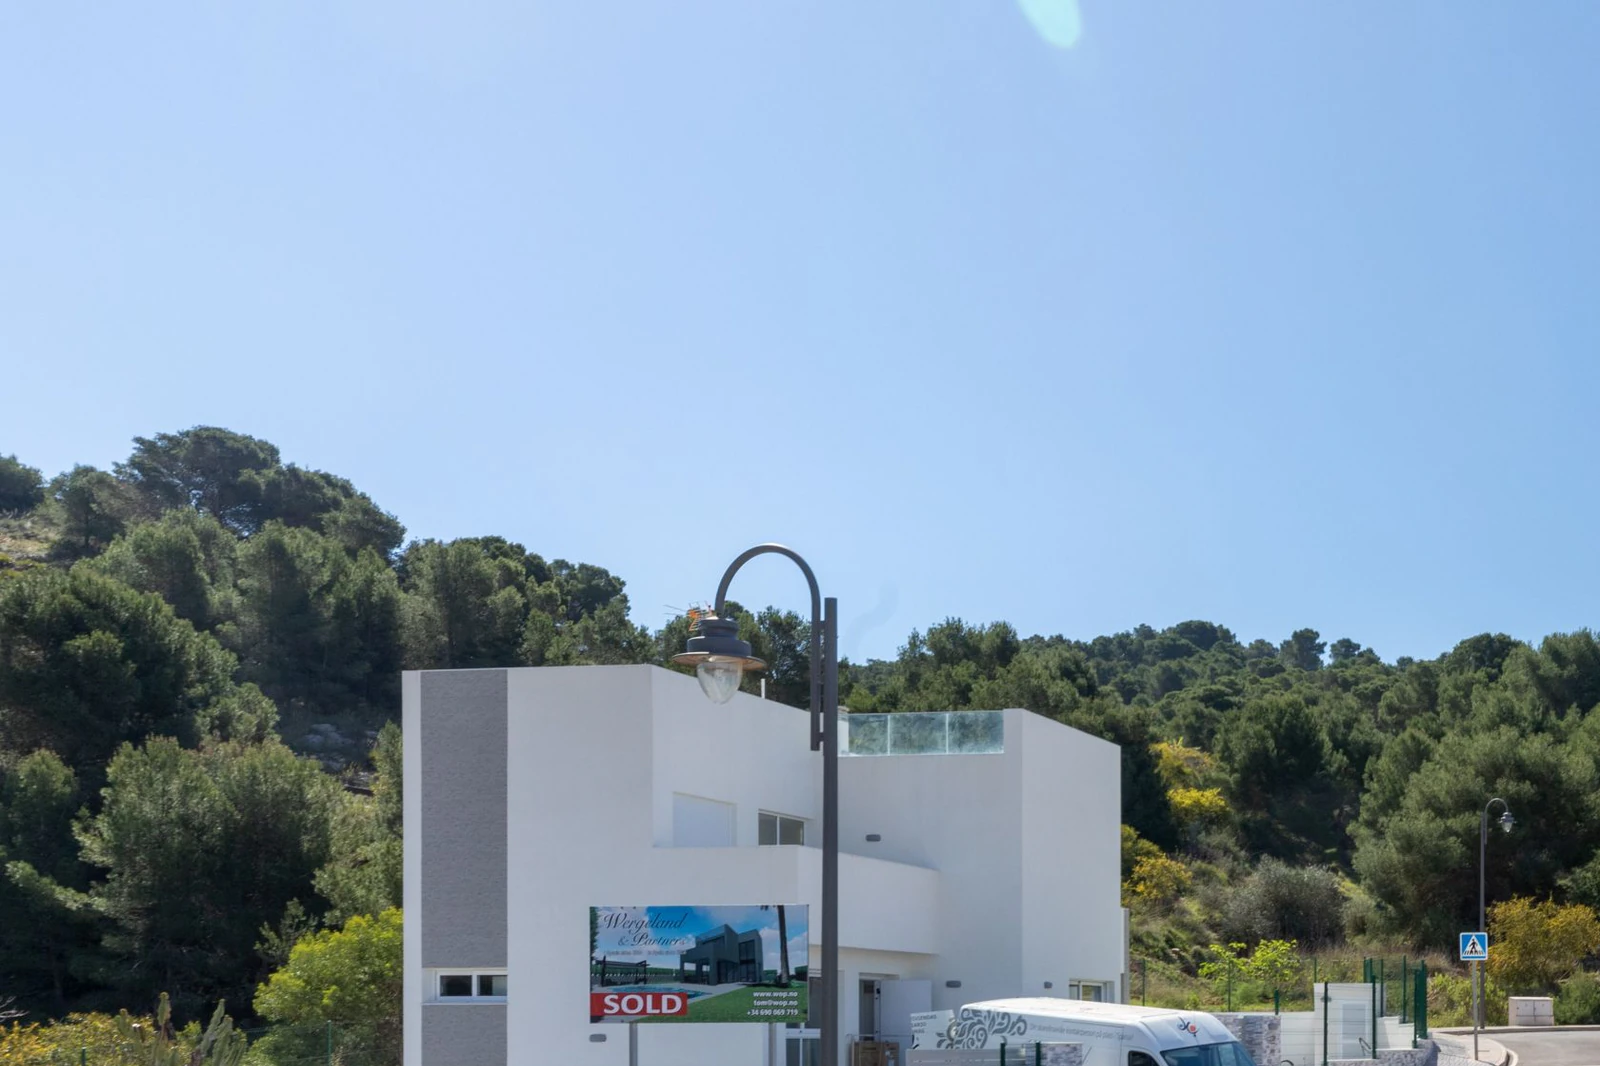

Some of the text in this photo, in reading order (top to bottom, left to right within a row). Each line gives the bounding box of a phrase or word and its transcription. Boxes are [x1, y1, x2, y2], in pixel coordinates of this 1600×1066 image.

[603, 913, 688, 934] Wergeland
[631, 933, 686, 946] Partners
[603, 994, 682, 1014] SOLD
